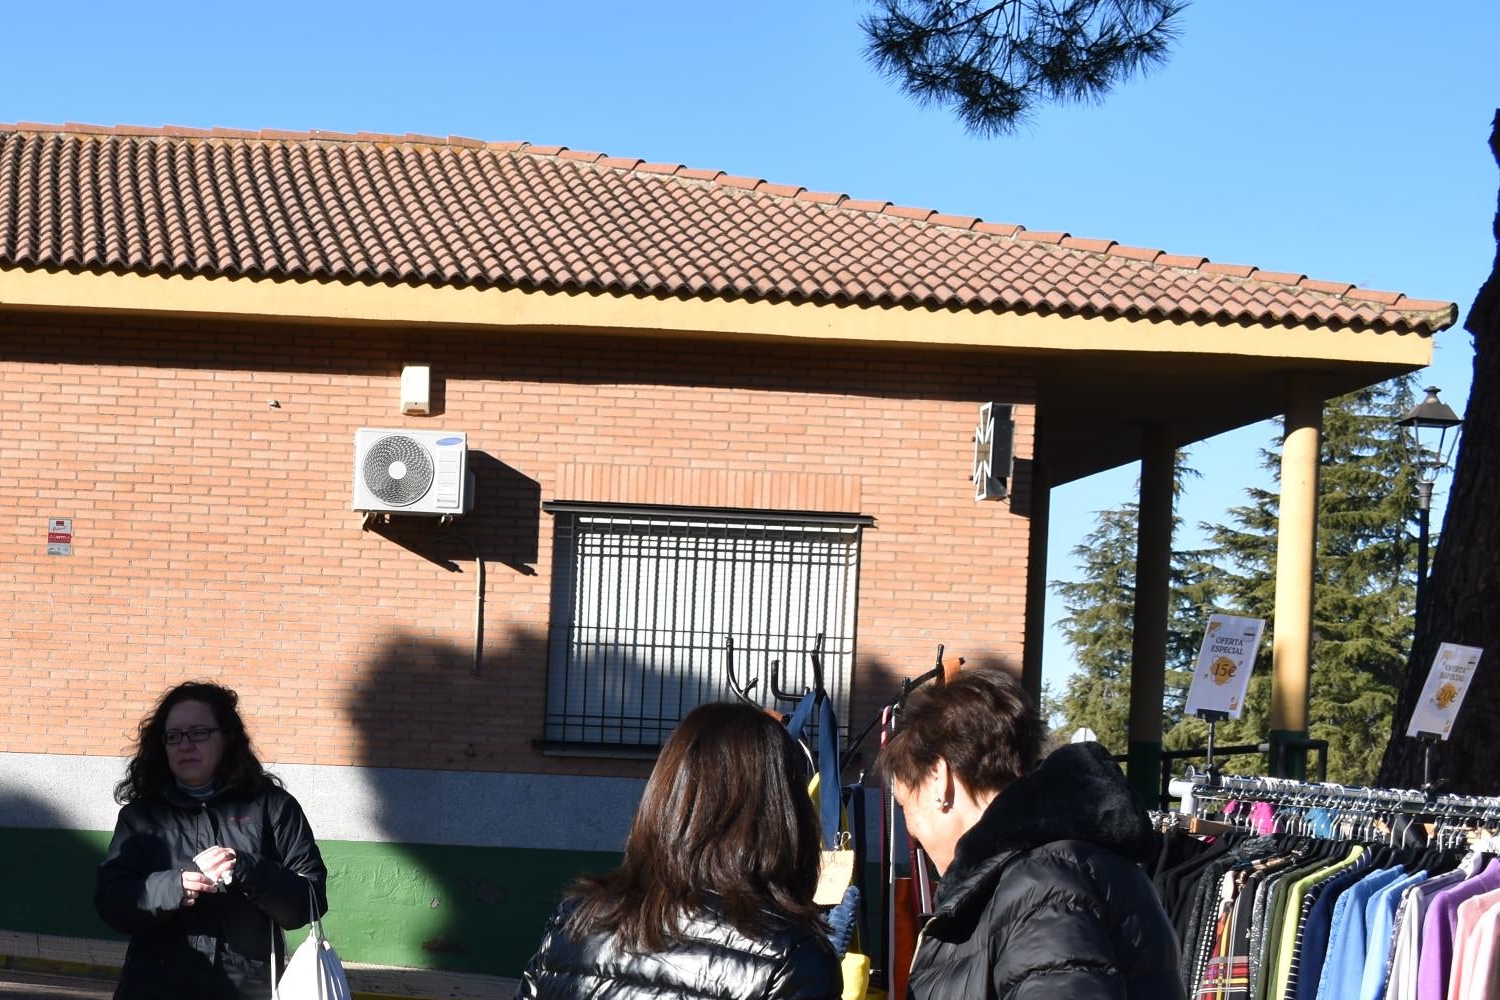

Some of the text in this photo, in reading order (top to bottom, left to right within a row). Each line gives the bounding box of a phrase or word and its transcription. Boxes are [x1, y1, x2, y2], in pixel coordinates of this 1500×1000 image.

[1215, 636, 1244, 647] OFERTA
[1210, 644, 1245, 656] ESPECIAL
[1214, 663, 1238, 678] 15€
